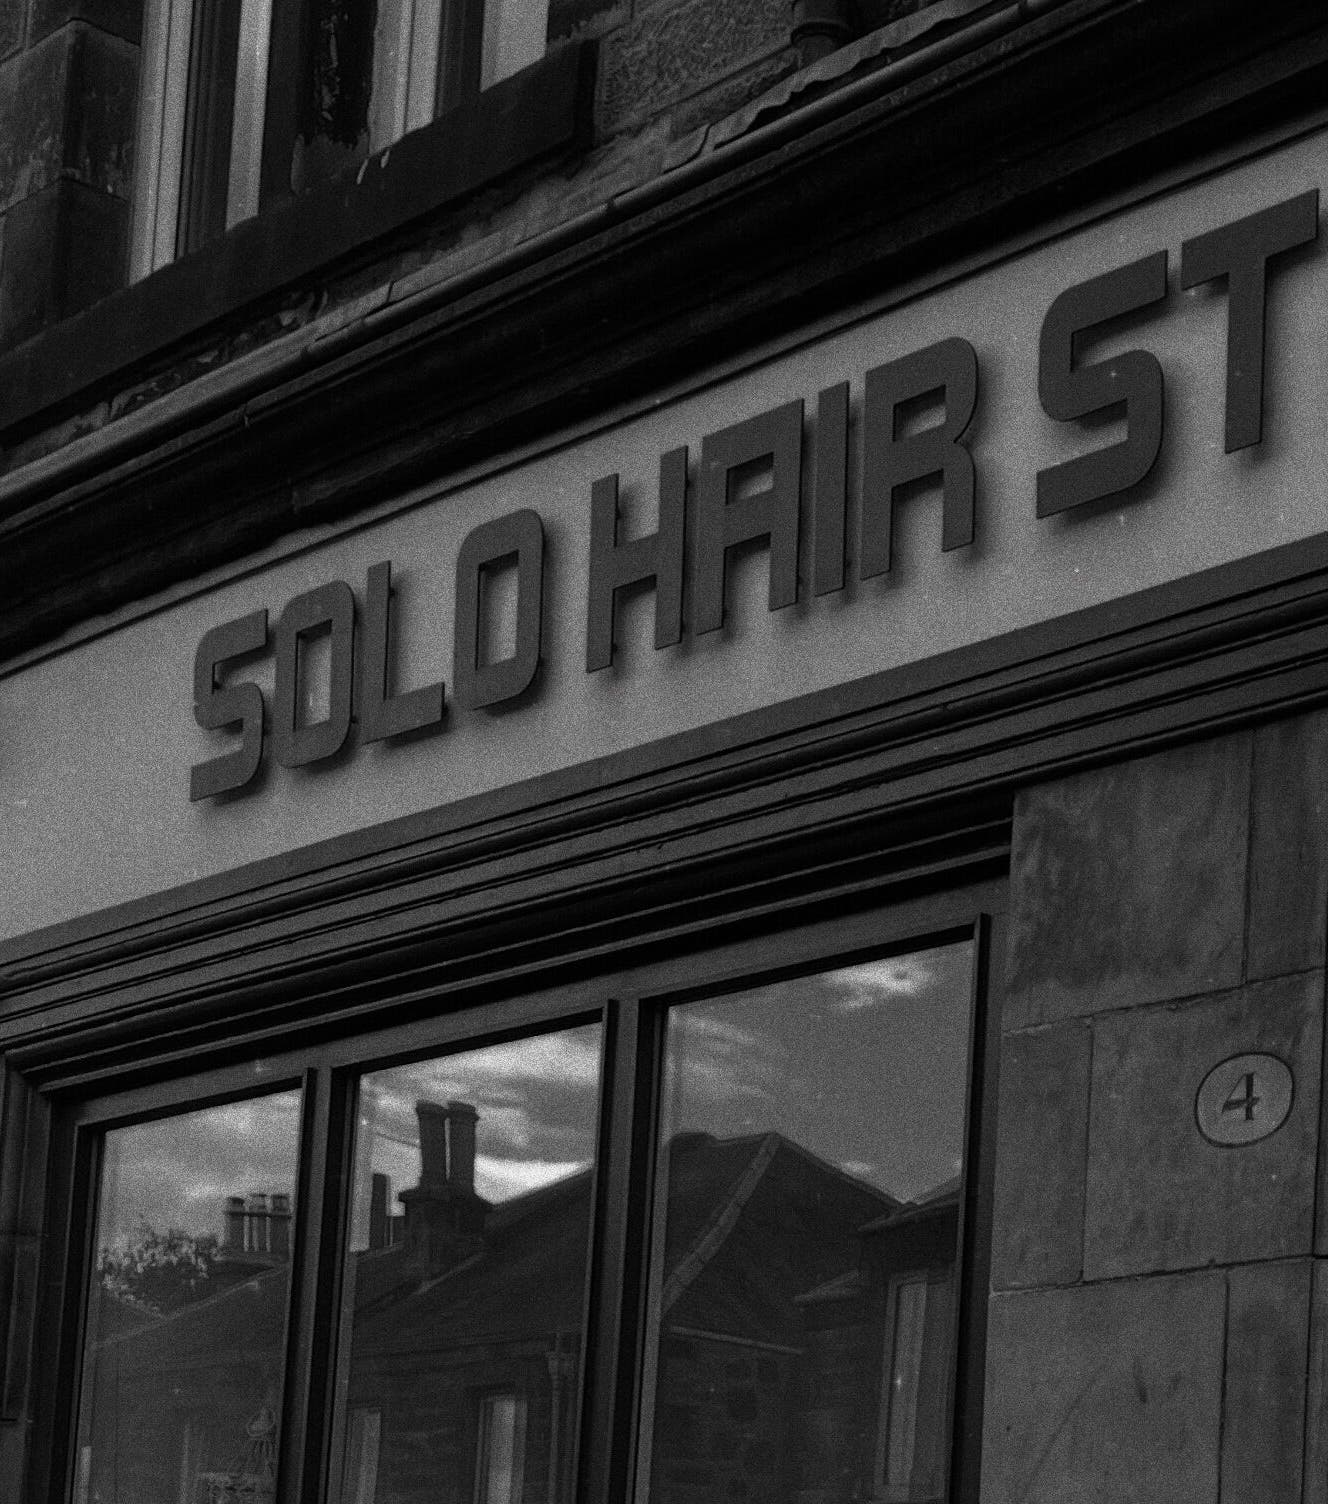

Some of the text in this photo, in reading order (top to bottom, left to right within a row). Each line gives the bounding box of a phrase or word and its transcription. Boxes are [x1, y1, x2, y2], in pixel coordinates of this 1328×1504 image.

[190, 508, 544, 802] SOLO
[586, 336, 979, 673] HAIR
[1220, 1072, 1260, 1121] 4
